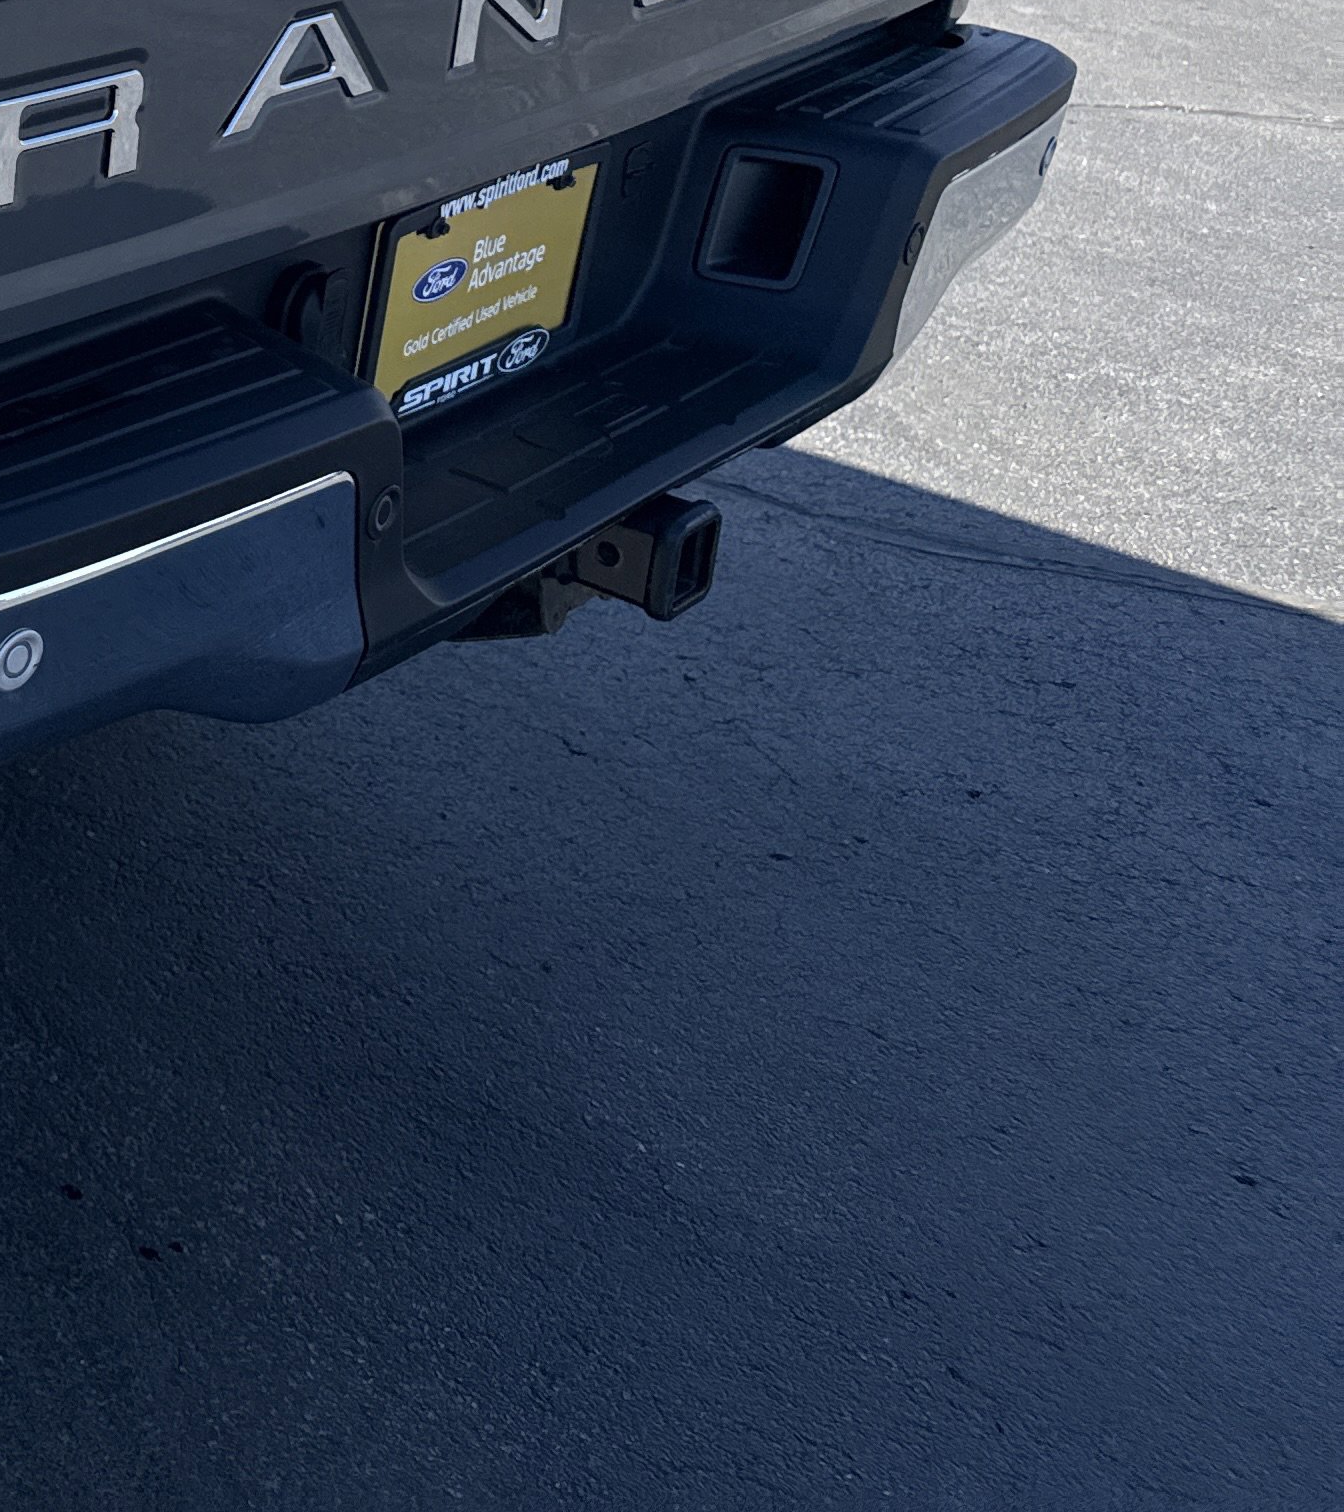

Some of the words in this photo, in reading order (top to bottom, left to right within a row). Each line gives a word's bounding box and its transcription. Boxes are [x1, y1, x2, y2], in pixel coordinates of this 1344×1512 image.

[440, 158, 570, 220] www.spiritford.com
[467, 244, 546, 292] Advantage
[473, 234, 507, 263] Blue
[422, 264, 459, 297] Ford
[403, 332, 430, 357] Gold
[431, 311, 474, 345] Certified
[475, 298, 501, 323] Used
[502, 284, 538, 310] Vehicle
[505, 334, 542, 368] Ford
[403, 353, 498, 404] SPIRIT
